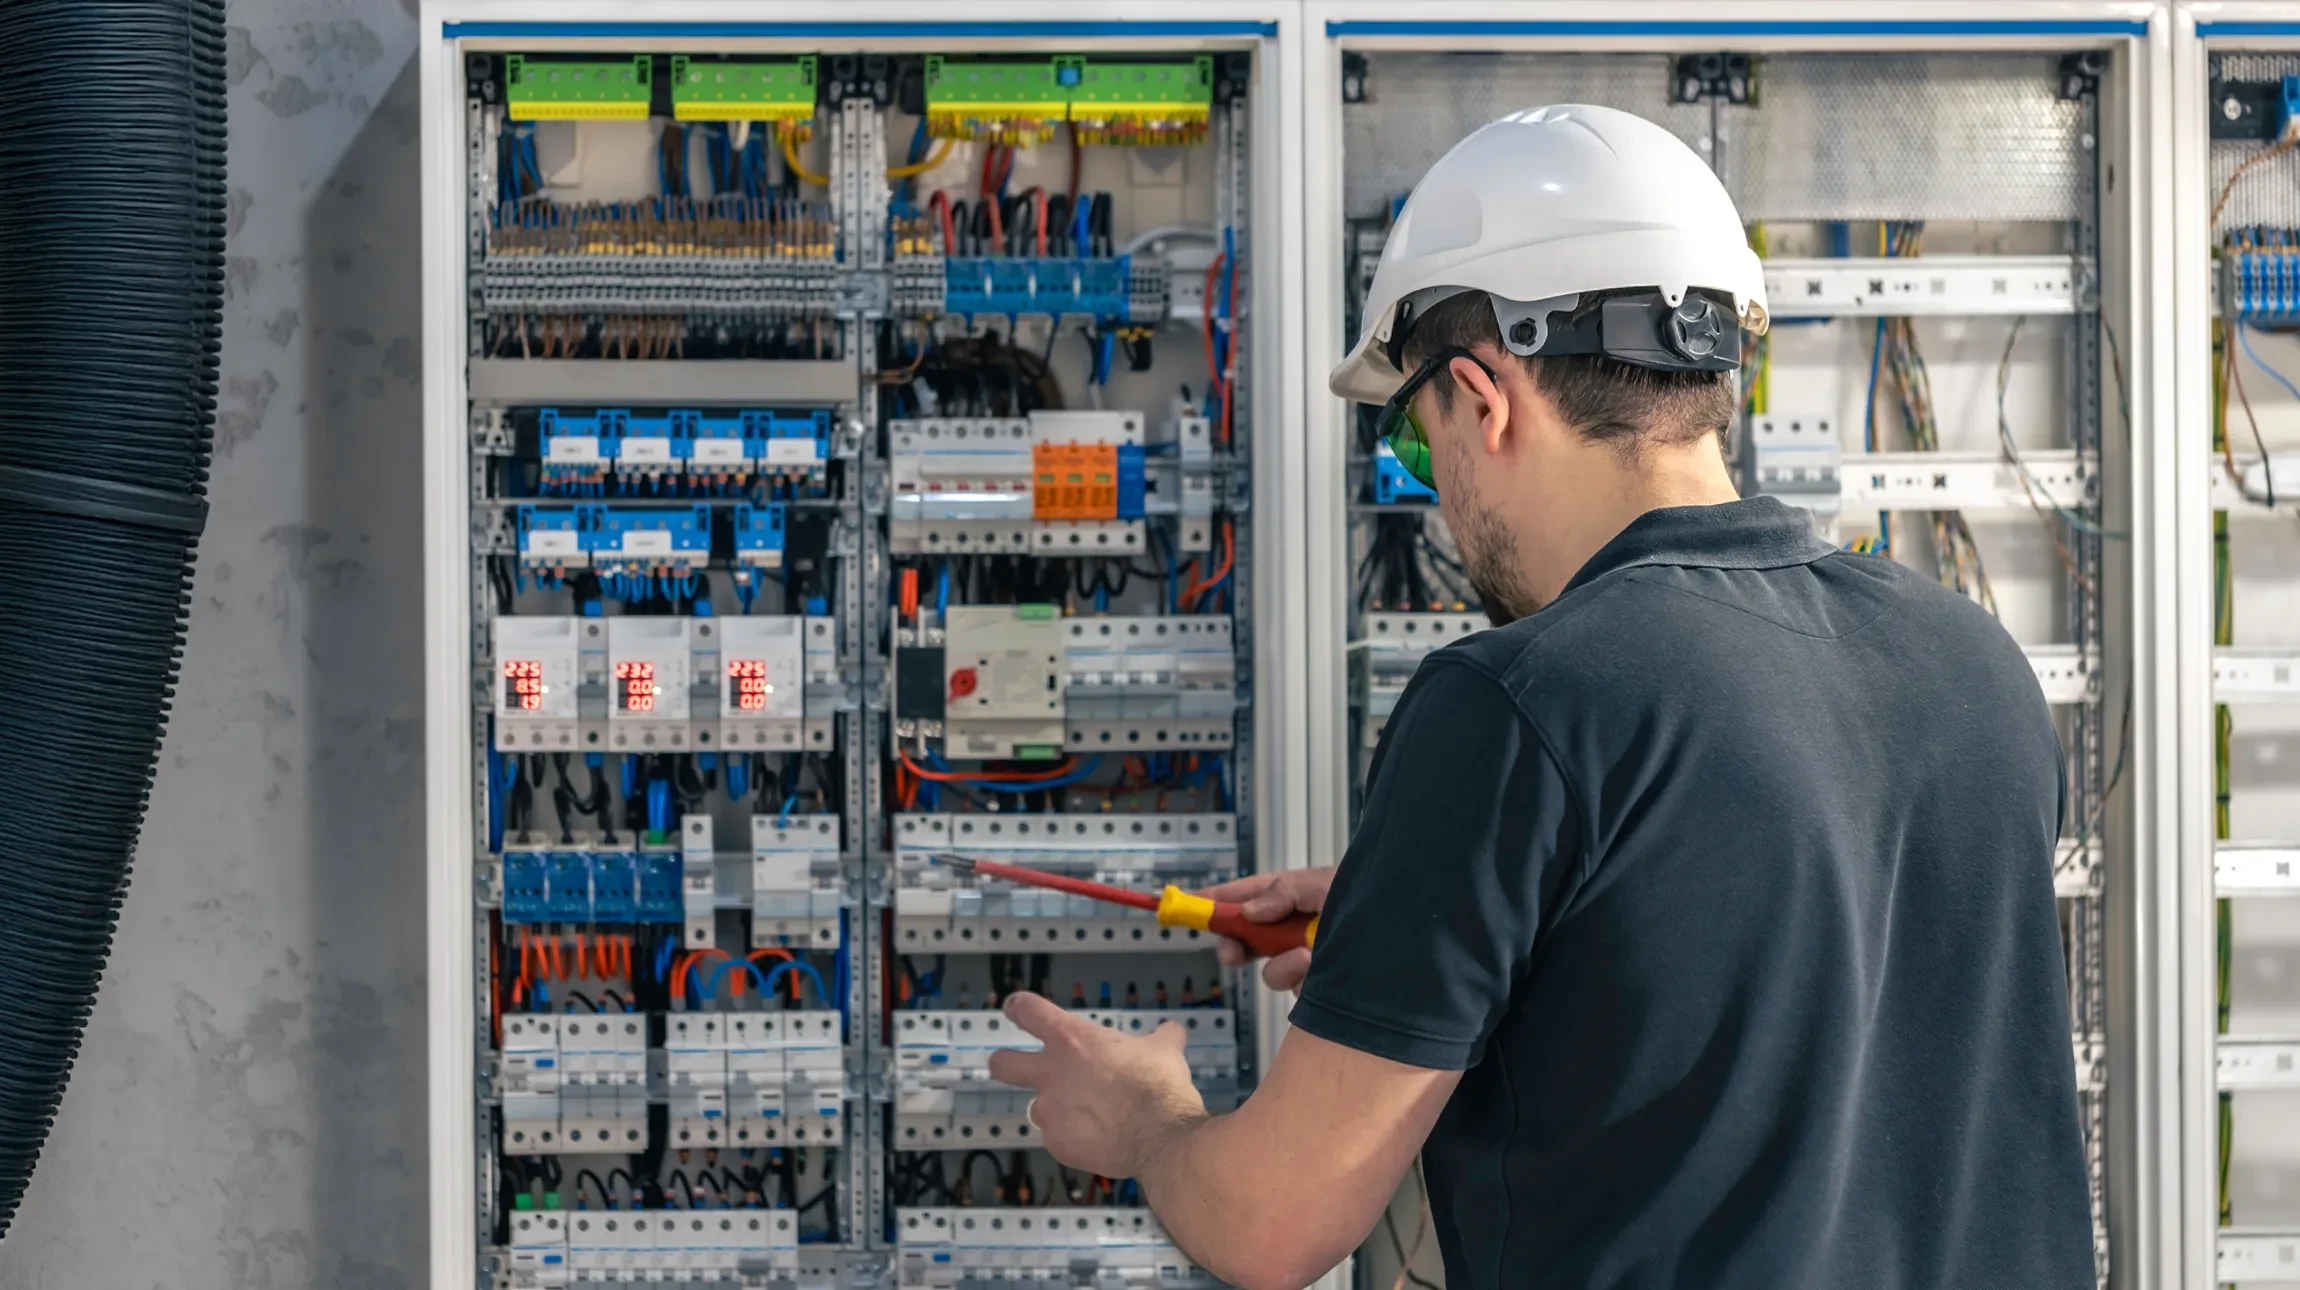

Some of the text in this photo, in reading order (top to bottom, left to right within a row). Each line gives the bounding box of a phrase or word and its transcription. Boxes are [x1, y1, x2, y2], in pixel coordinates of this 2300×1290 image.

[505, 660, 540, 677] 225
[616, 660, 653, 678] 232
[729, 660, 765, 677] 225
